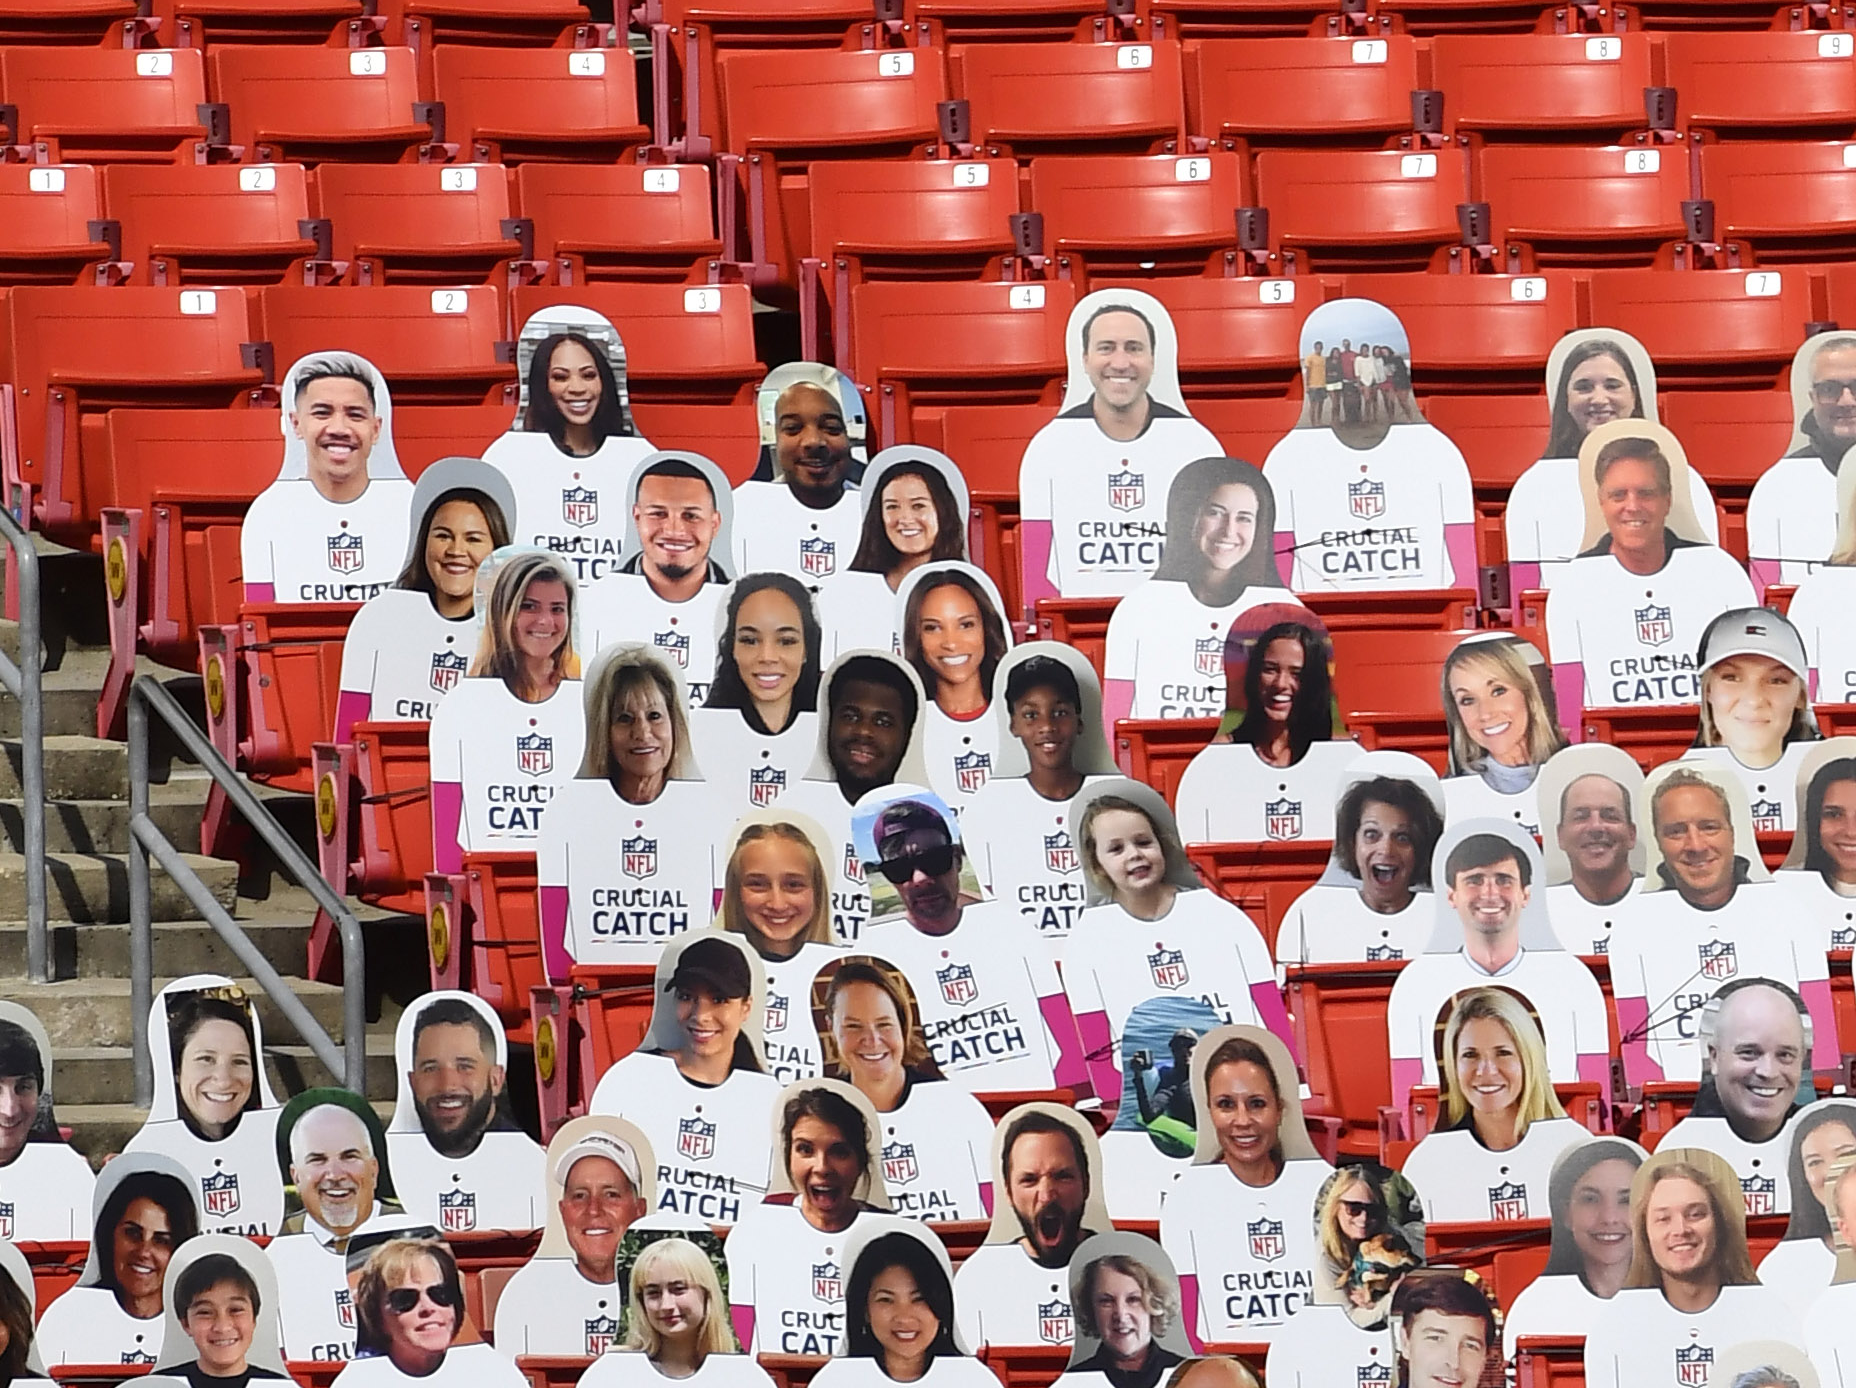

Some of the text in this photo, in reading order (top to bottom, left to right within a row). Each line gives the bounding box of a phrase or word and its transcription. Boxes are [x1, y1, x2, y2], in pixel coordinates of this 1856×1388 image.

[1112, 487, 1142, 508] NFL
[1353, 496, 1383, 517] NFL
[566, 502, 596, 523] NFL
[1320, 527, 1419, 548] CRUCIAL
[331, 549, 361, 570] NFL
[804, 553, 834, 574] NFL
[1322, 548, 1422, 576] CATCH
[1640, 621, 1670, 642] NFL
[521, 750, 551, 771] NFL
[1270, 817, 1300, 838] NFL
[625, 853, 655, 874] NFL
[592, 887, 689, 910] CRUCIAL
[591, 910, 688, 937] CATCH
[1155, 964, 1185, 985] NFL
[944, 980, 974, 1001] NFL
[924, 1006, 1018, 1043] CRUCIAL
[929, 1024, 1026, 1067] CATCH
[681, 1134, 711, 1155] NFL
[657, 1164, 742, 1195] RUCIAL
[885, 1159, 915, 1180] NFL
[207, 1190, 237, 1211] NFL
[658, 1192, 740, 1223] ATCH
[1253, 1236, 1282, 1257] NFL
[1043, 1318, 1073, 1339] NFL
